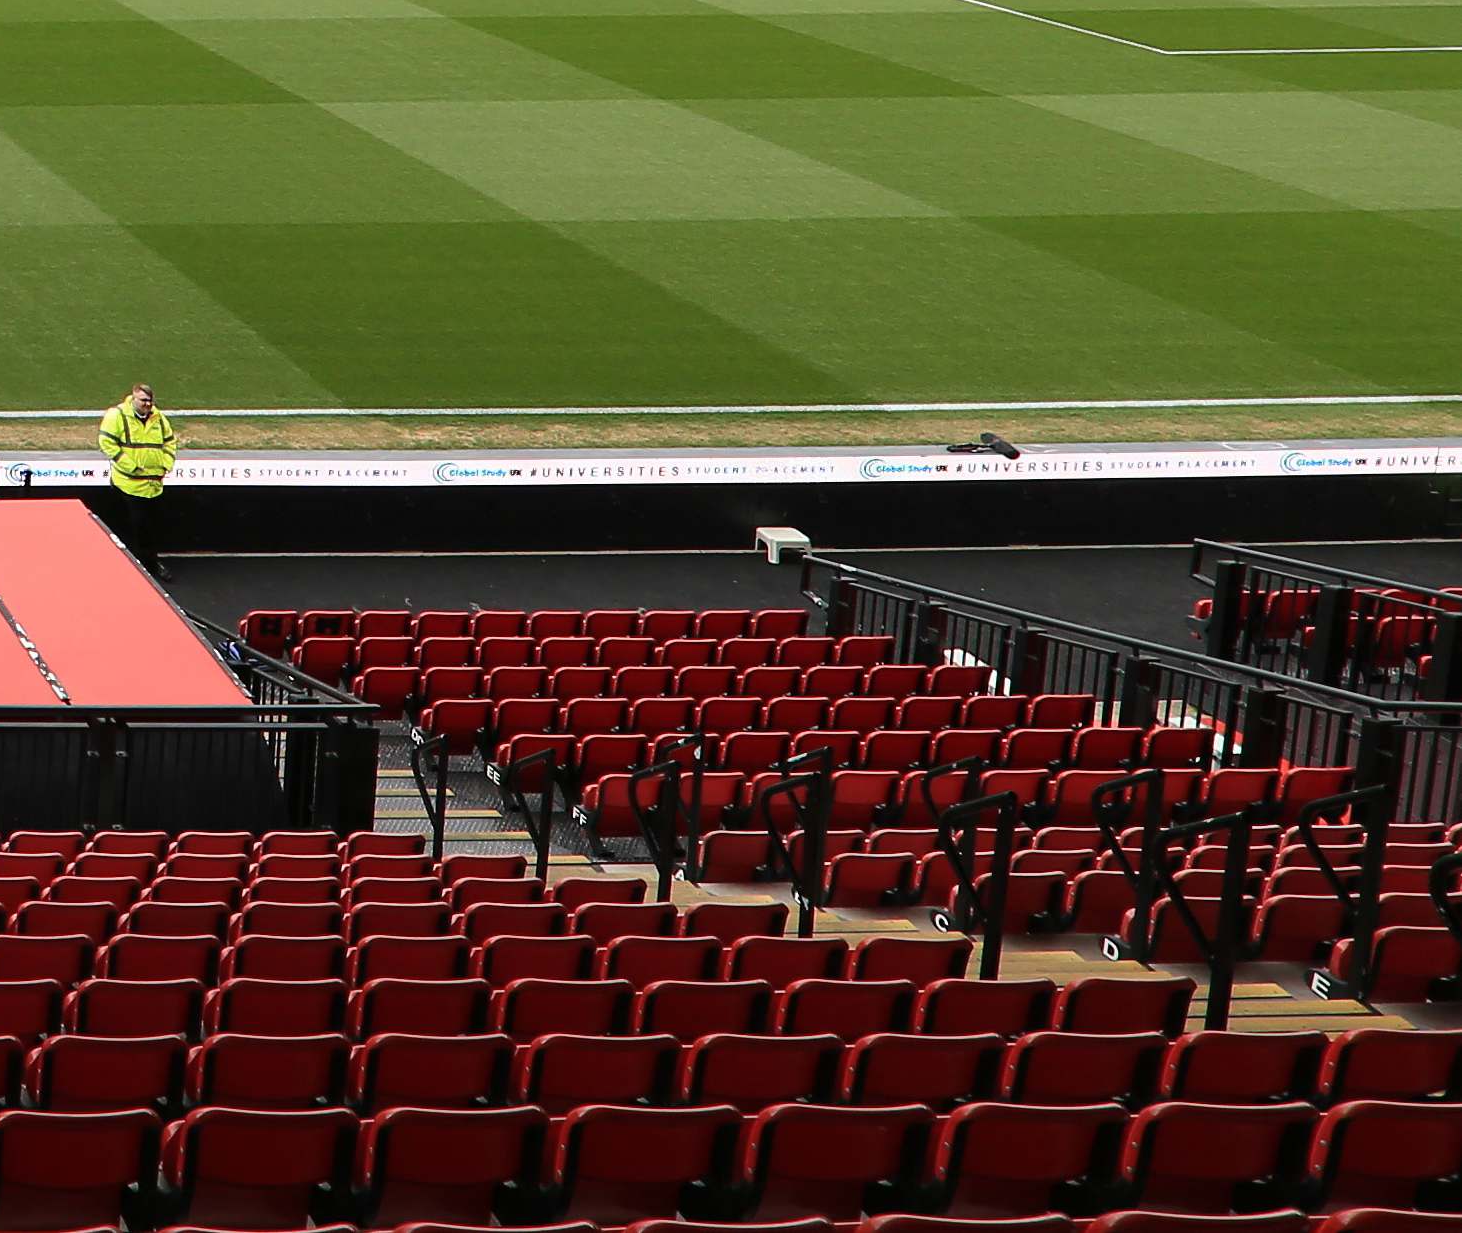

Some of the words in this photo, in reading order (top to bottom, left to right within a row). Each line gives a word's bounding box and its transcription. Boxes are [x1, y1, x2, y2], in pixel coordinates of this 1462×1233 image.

[876, 465, 906, 473] Global
[908, 465, 932, 474] Study
[1328, 458, 1352, 467] Study
[55, 470, 79, 478] Study
[450, 469, 480, 477] Global
[482, 469, 506, 478] Study
[486, 764, 501, 786] EE
[572, 806, 587, 826] FF
[935, 912, 949, 932] C
[1102, 936, 1120, 961] D
[1311, 972, 1331, 1000] E
